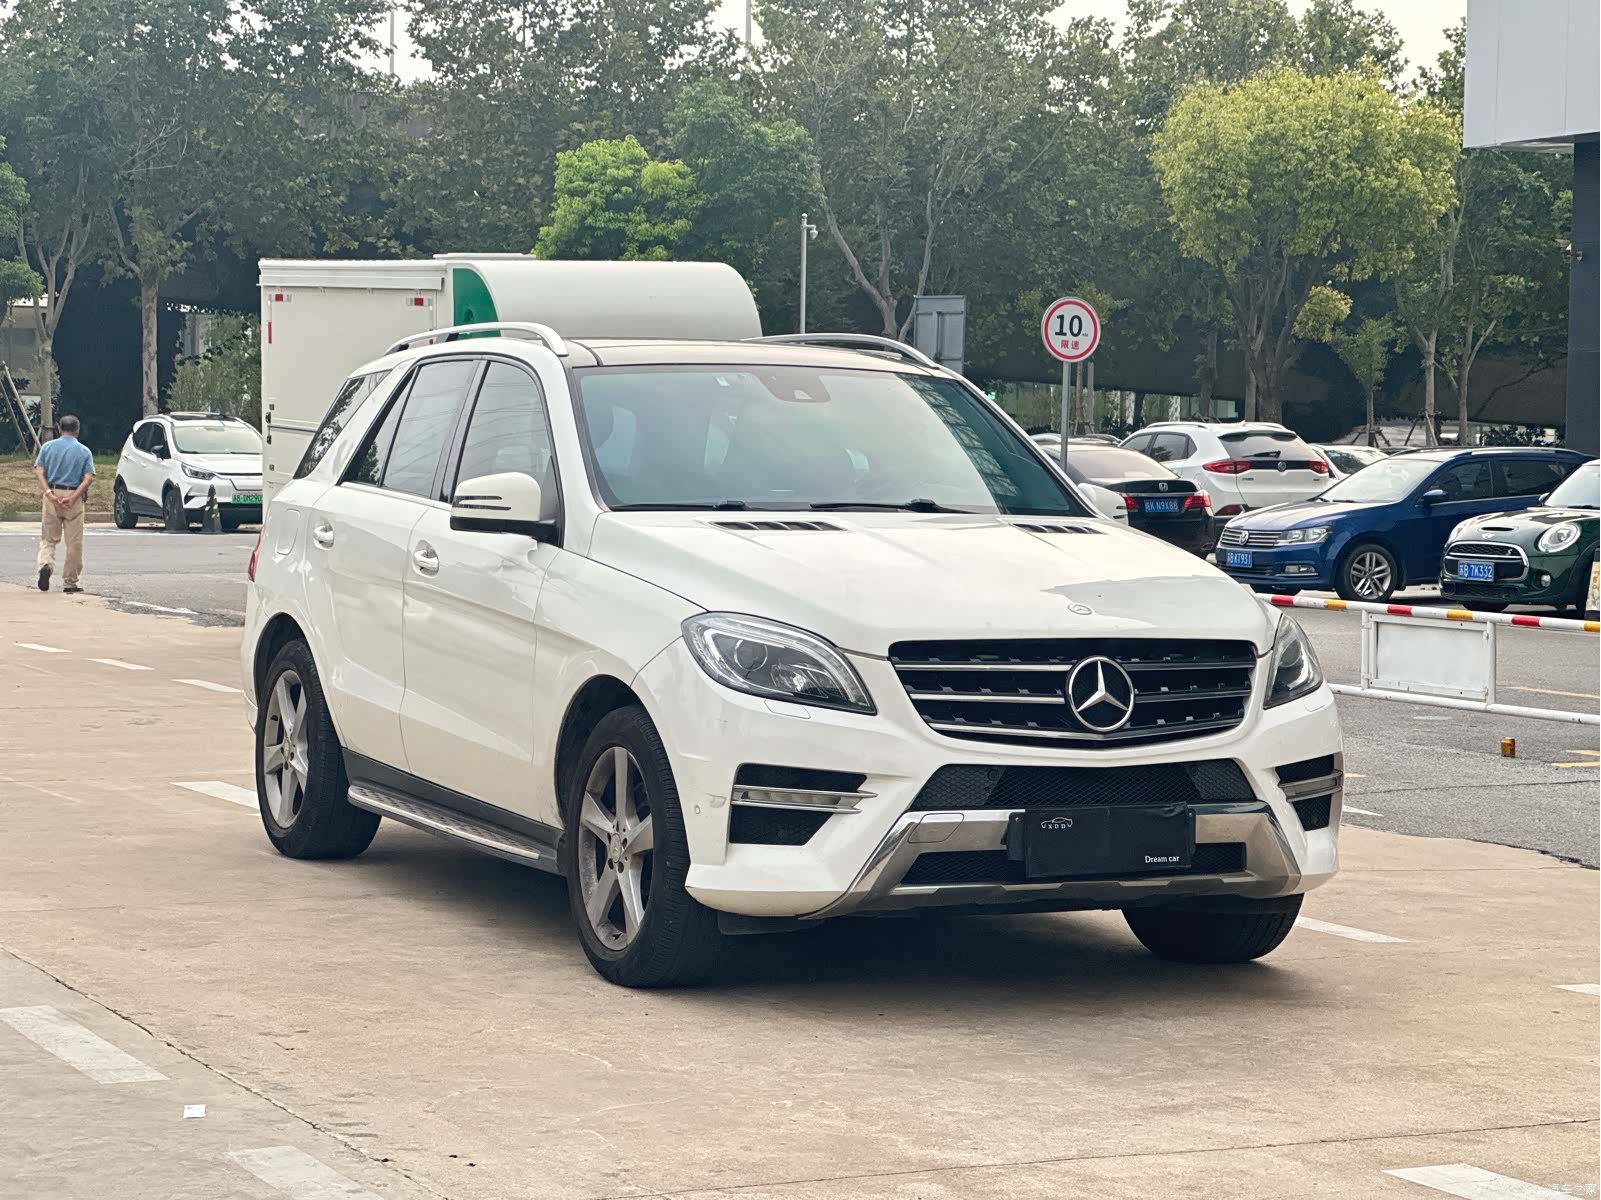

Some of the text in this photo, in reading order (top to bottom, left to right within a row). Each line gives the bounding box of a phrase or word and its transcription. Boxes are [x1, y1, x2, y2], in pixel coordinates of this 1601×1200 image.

[1055, 314, 1082, 337] 10
[1061, 340, 1079, 350] 限速
[1470, 564, 1493, 578] 7K332
[1144, 855, 1168, 864] Dream
